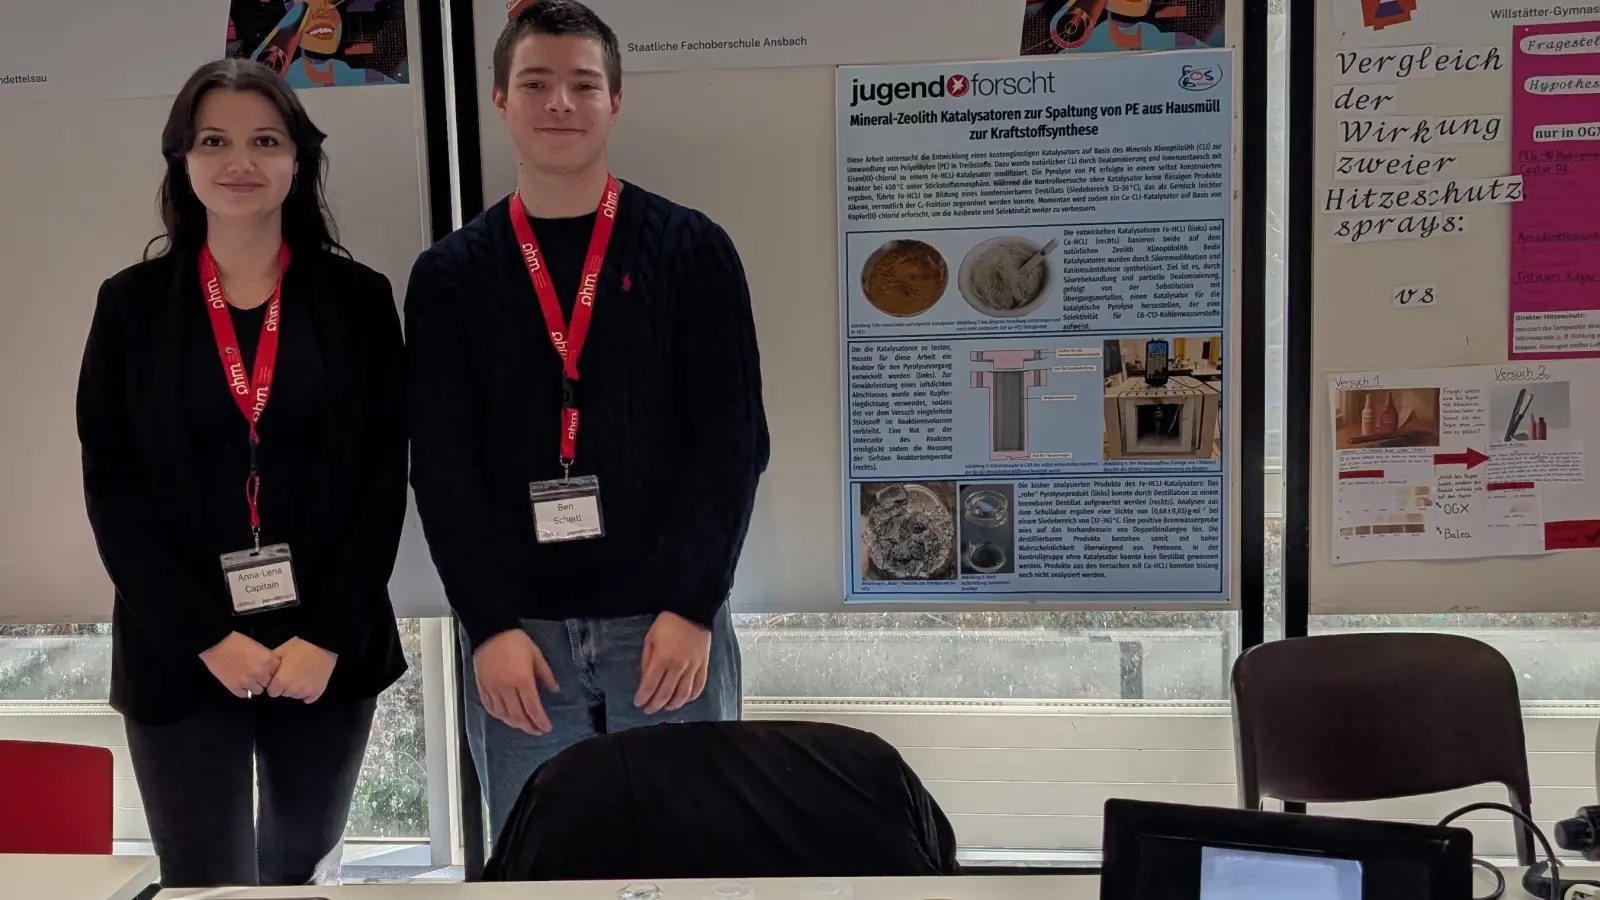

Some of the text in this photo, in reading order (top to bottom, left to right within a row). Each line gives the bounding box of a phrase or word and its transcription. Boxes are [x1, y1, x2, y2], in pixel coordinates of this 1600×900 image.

[1491, 6, 1600, 19] Willstätter-Gymnas
[628, 36, 807, 52] Staatliche Fachoberschule Ansbach
[1336, 47, 1503, 77] Vergleich
[851, 72, 1055, 106] jugend forscht
[1334, 87, 1394, 110] der
[850, 100, 1219, 126] Mineral-Zeolith Katalysatoren zur Spaltung von PE aus Hausmüll
[969, 123, 1098, 140] zur Kraftstoffsynthese
[1340, 118, 1501, 143] Wirkung
[1535, 128, 1559, 139] nur
[1562, 126, 1574, 137] in
[1337, 154, 1456, 175] zweier
[1324, 179, 1522, 211] Hitzeschutz
[1334, 214, 1464, 242] sprays:
[1495, 366, 1534, 379] Versuch
[1335, 376, 1368, 387] Versuch
[1444, 503, 1469, 515] OGX
[1444, 528, 1472, 539] Balea
[238, 567, 283, 581] Anna-Lena
[245, 581, 279, 593] Capitain
